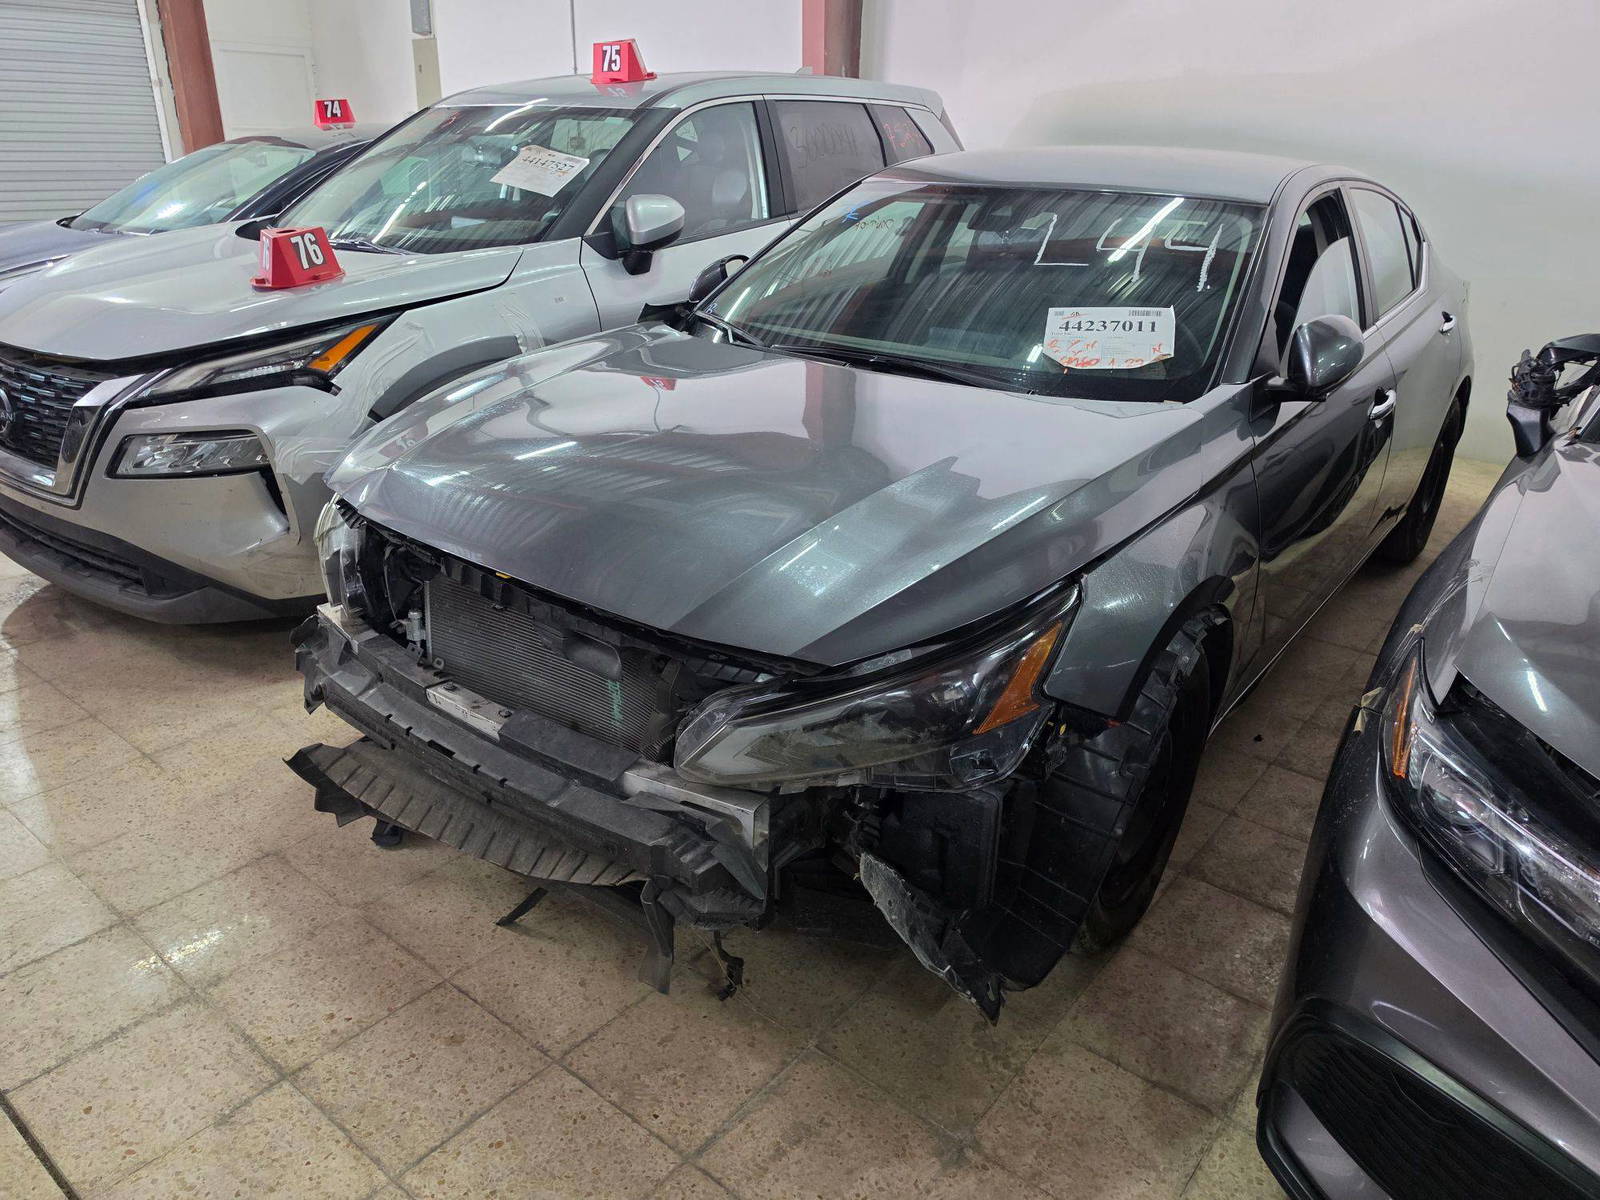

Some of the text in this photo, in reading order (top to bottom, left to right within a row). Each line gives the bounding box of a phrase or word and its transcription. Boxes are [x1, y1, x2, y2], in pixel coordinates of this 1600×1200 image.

[602, 45, 621, 72] 75
[324, 100, 342, 118] 74
[290, 232, 324, 270] 76
[1058, 320, 1157, 333] 44237011
